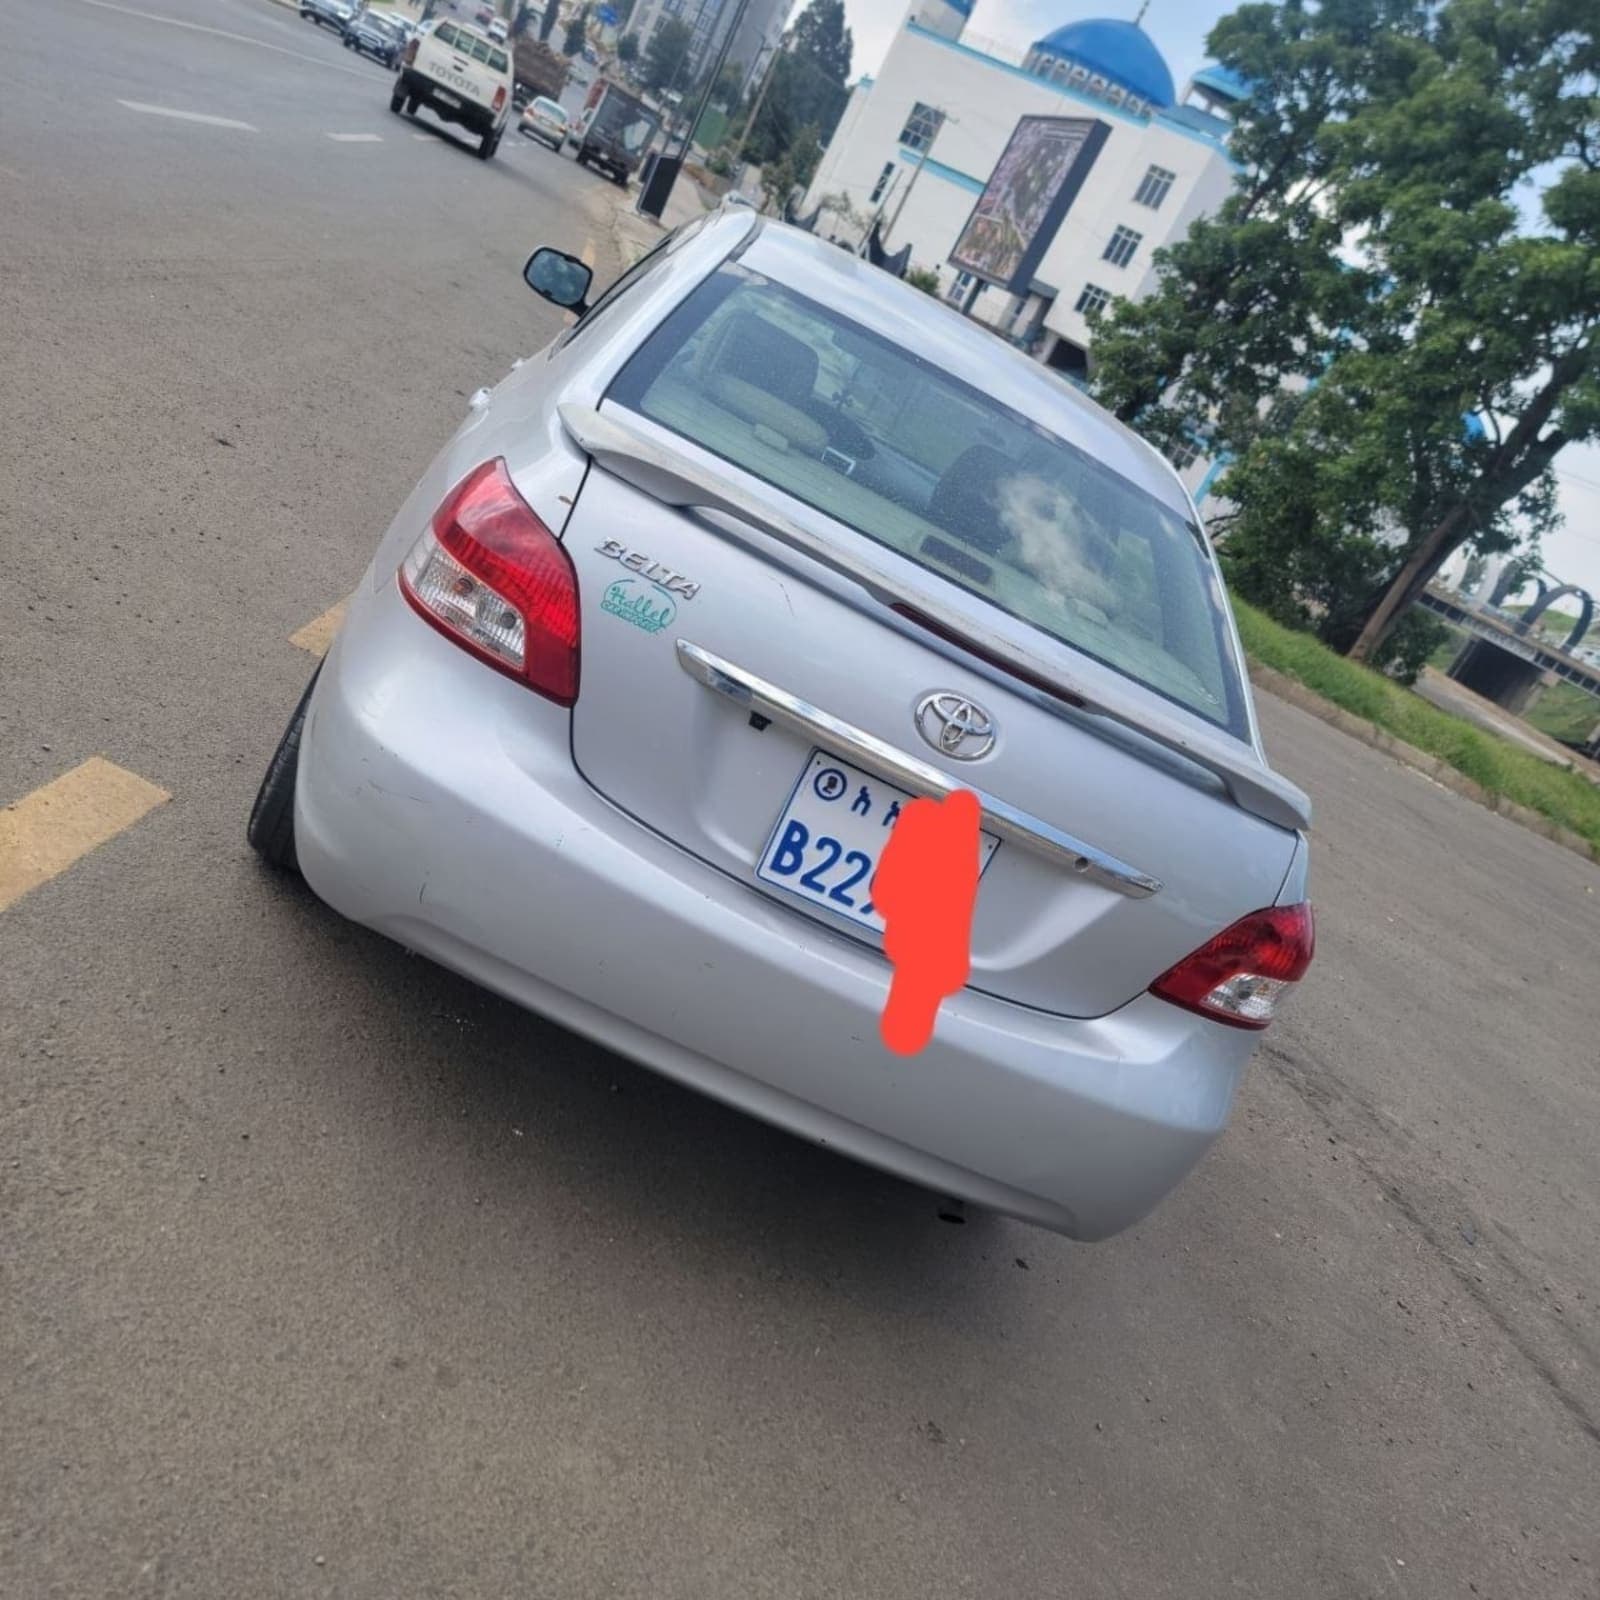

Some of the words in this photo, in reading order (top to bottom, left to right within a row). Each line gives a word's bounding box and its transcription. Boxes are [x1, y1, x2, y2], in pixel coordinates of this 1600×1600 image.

[430, 62, 480, 96] TOYOTA
[594, 537, 701, 600] BELTA
[769, 819, 875, 915] B22
